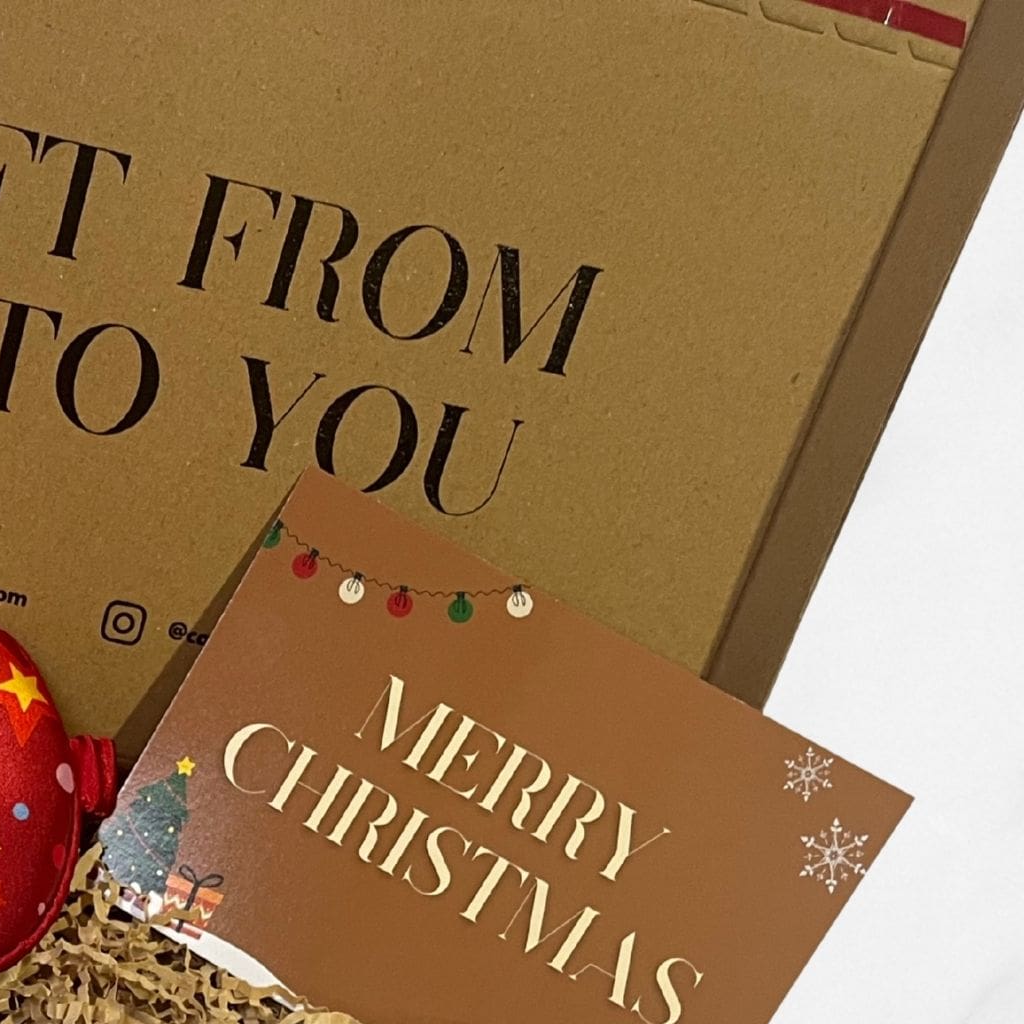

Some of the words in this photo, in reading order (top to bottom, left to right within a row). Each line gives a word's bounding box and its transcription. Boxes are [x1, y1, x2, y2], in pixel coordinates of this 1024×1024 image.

[176, 173, 604, 376] FROM
[240, 355, 525, 516] YOU
[353, 674, 672, 882] MERRY
